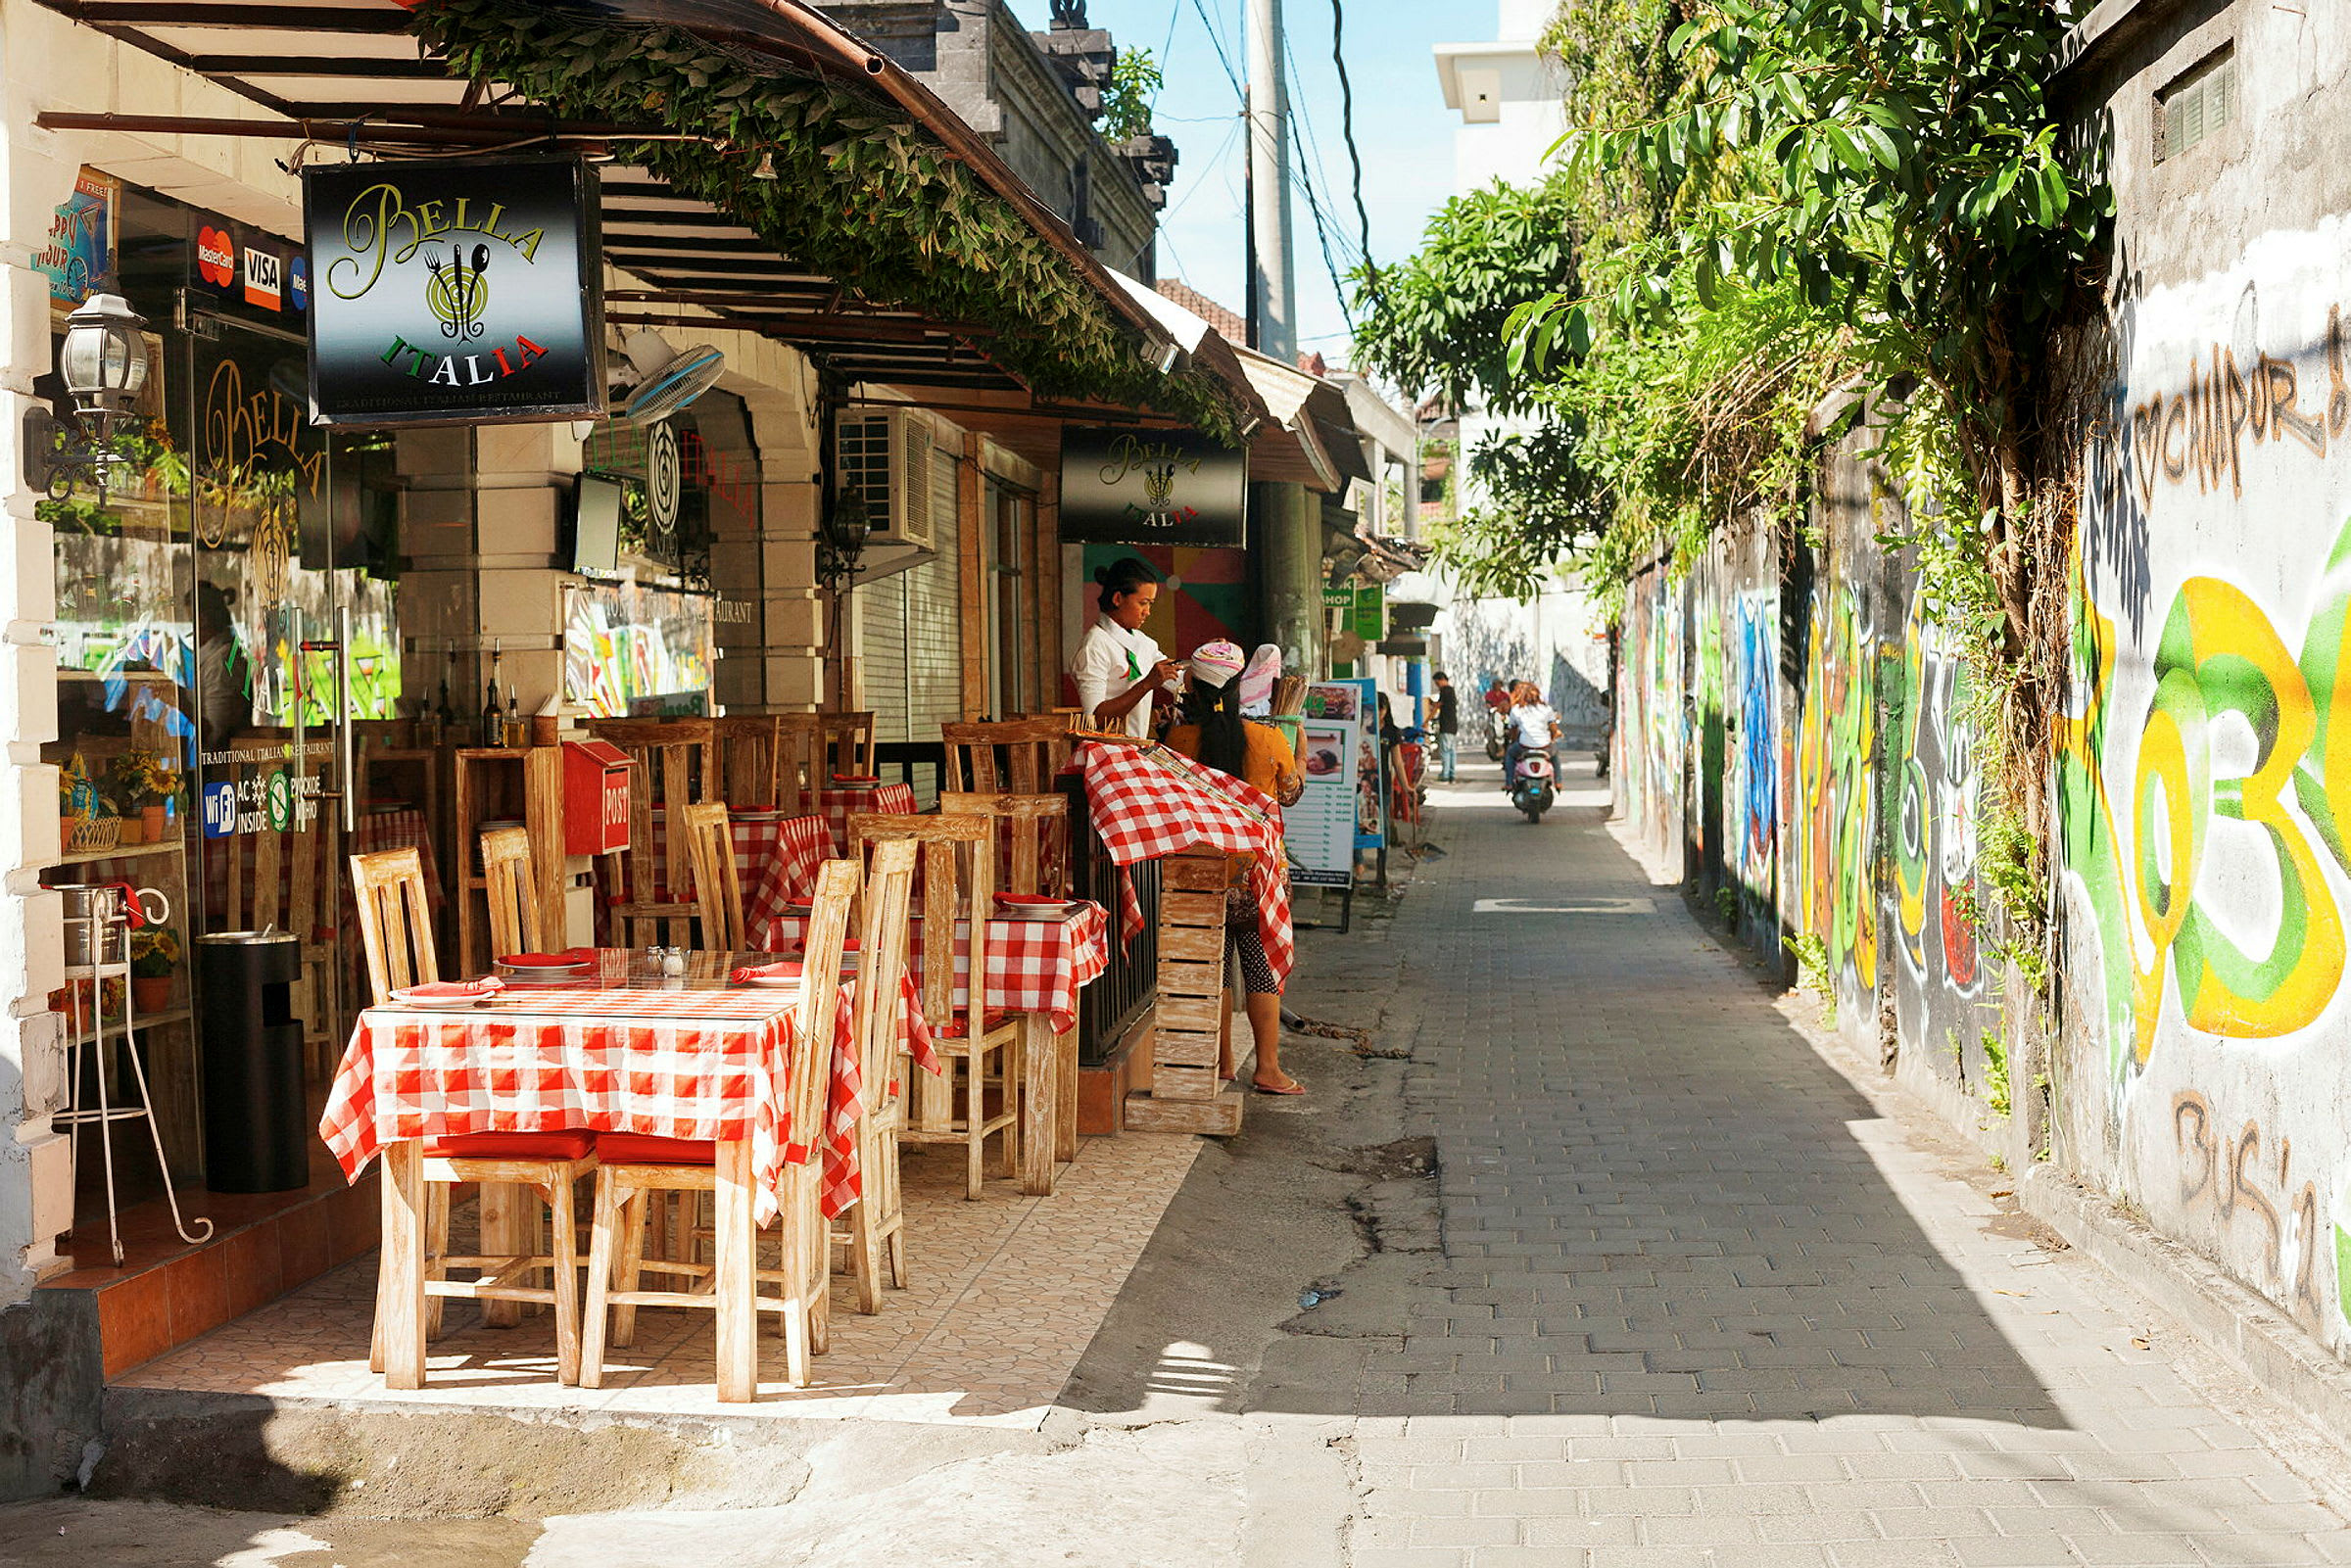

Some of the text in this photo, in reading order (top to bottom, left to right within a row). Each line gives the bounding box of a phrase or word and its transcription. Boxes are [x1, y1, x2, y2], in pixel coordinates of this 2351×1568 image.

[198, 244, 233, 269] MasterCard
[326, 183, 545, 300] BELLA
[246, 250, 278, 290] VISA
[380, 334, 549, 387] ITALIA
[197, 358, 321, 549] BELLA
[1099, 433, 1202, 486] BELLA
[1124, 501, 1199, 528] ITALIA
[201, 749, 255, 765] TRADITIONAL
[257, 746, 285, 762] ITALIAN
[237, 781, 250, 802] AC
[605, 785, 628, 827] POST
[237, 810, 267, 834] INSIDE
